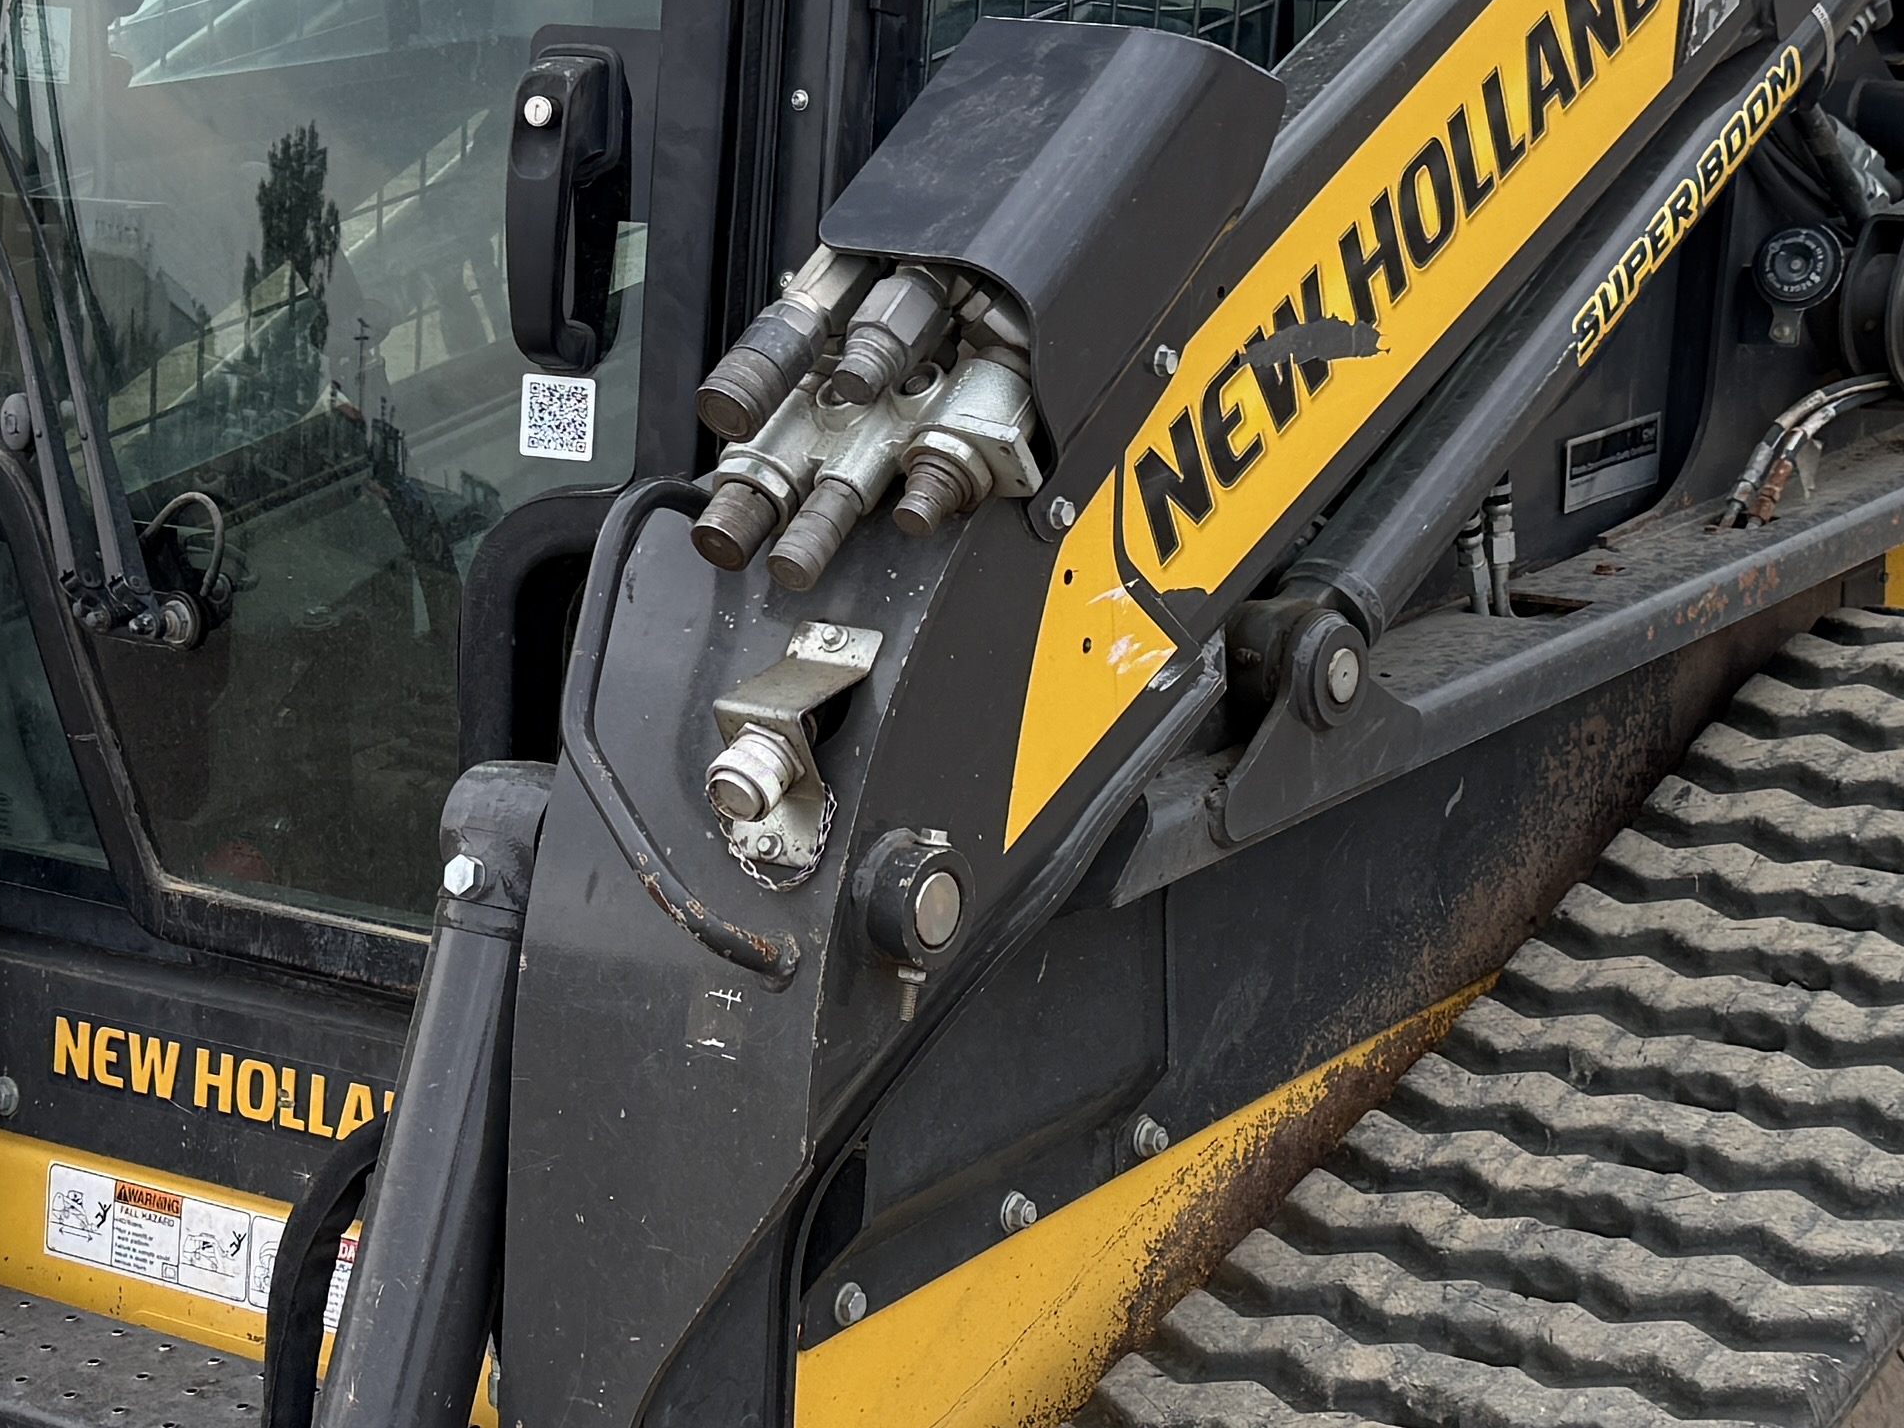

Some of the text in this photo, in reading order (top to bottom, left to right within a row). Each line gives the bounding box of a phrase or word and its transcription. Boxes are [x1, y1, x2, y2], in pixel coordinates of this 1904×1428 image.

[1572, 178, 1699, 367] SUPER
[1696, 45, 1802, 207] BOOM
[1134, 263, 1332, 566] NEW
[53, 1016, 180, 1099] NEW
[120, 1205, 139, 1219] FALL
[128, 1187, 180, 1215] WARNING
